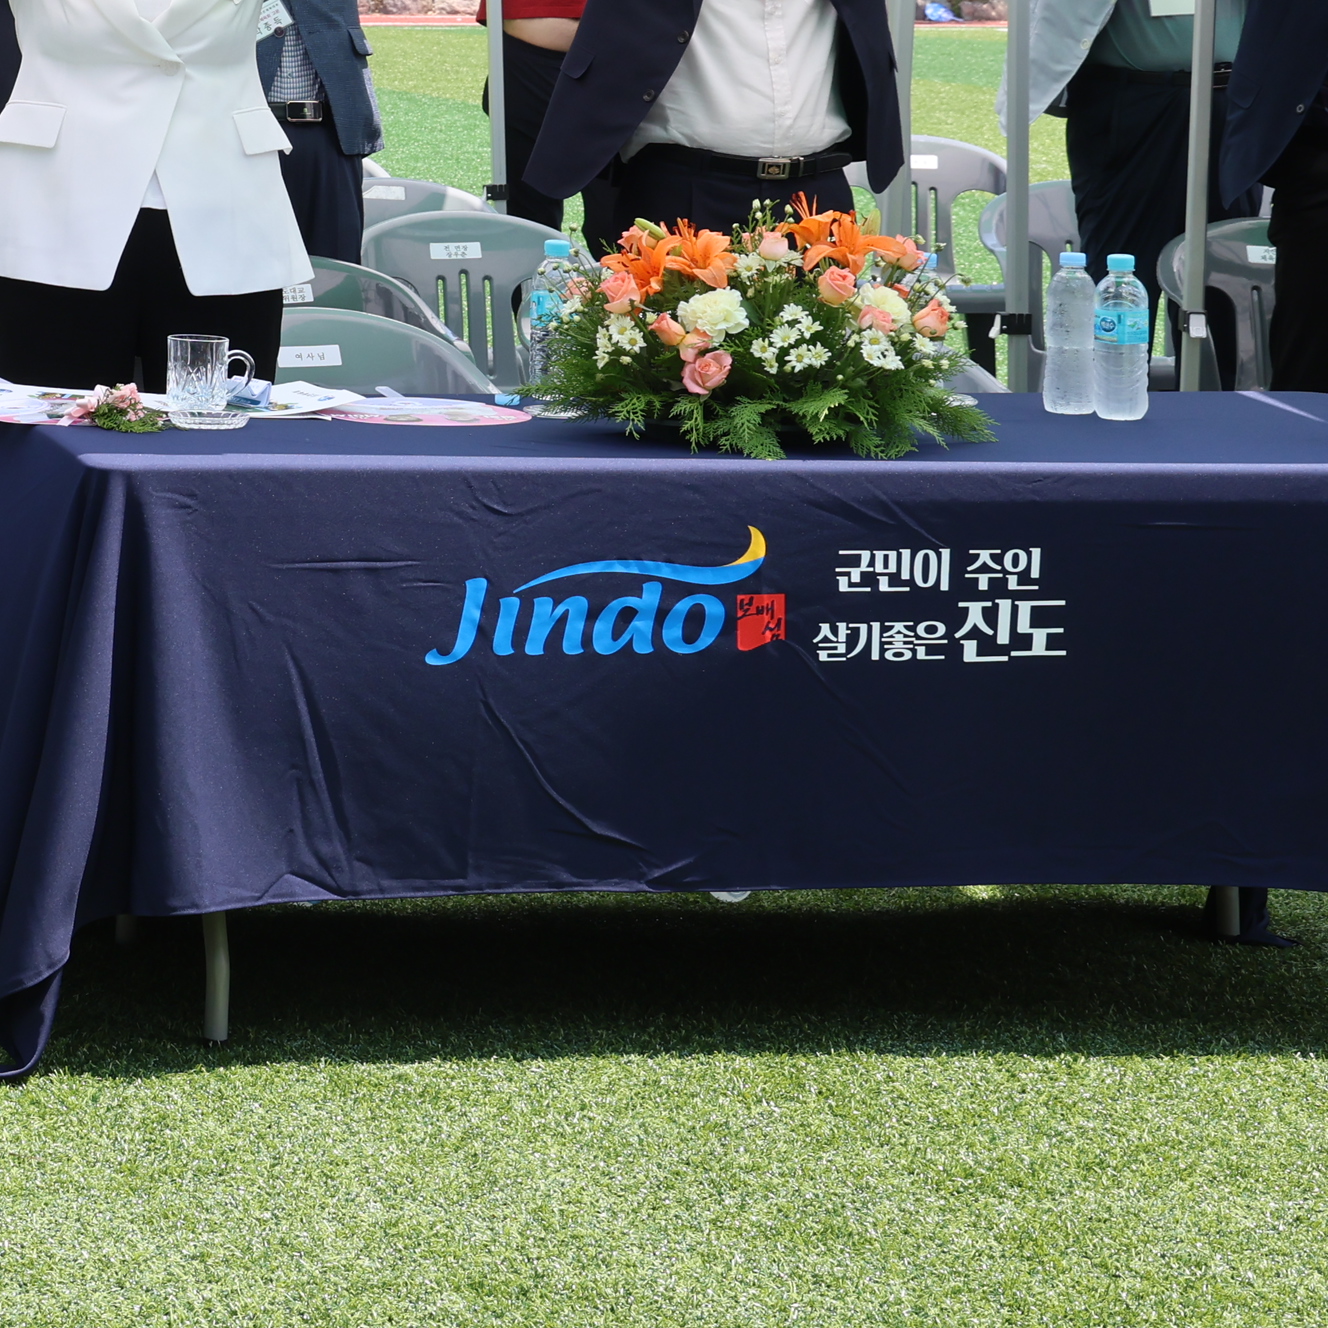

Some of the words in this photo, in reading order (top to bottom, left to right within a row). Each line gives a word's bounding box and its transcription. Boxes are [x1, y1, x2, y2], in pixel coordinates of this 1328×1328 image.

[835, 547, 951, 592] 군민이
[964, 547, 1042, 591] 주인
[424, 577, 726, 666] Jindo
[812, 620, 948, 662] 살기좋은
[954, 598, 1067, 663] 진도
